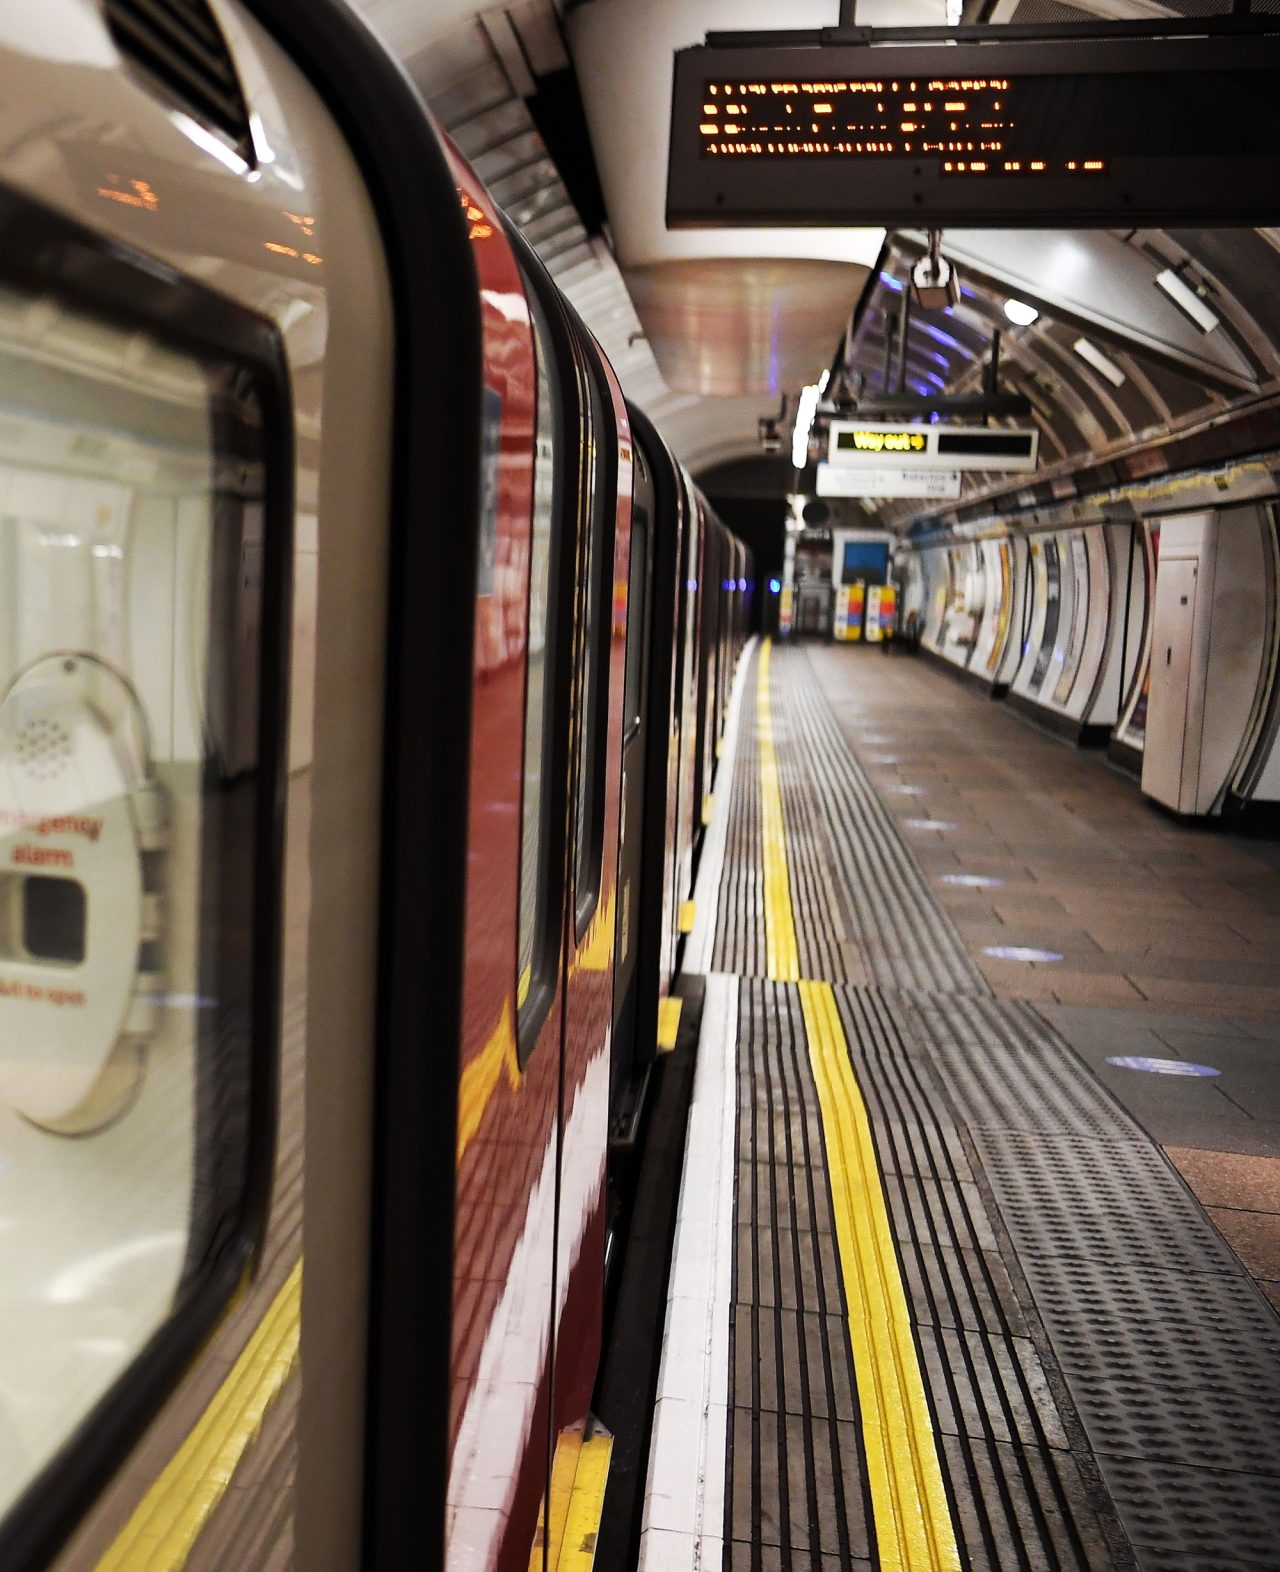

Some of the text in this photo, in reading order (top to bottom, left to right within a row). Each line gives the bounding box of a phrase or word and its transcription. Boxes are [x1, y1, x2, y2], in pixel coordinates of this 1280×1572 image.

[853, 431, 910, 452] Way out
[10, 843, 75, 867] alarm
